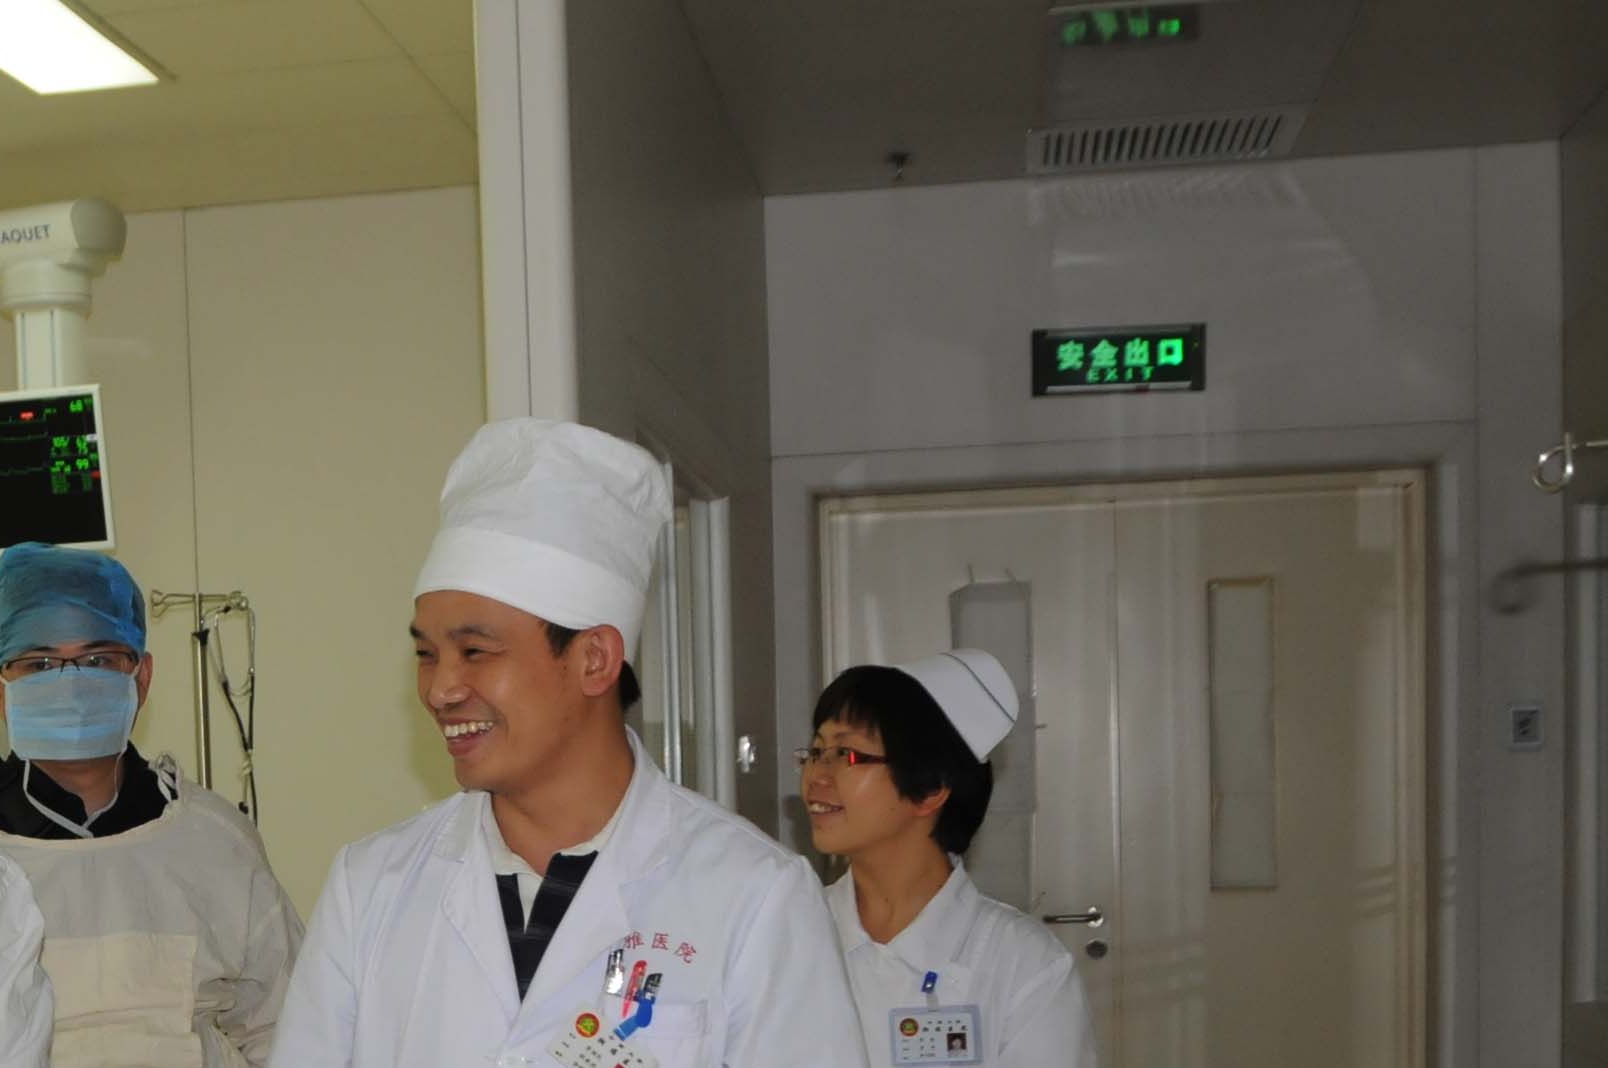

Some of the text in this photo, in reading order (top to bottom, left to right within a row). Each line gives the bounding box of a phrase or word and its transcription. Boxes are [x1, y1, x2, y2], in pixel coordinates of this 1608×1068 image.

[1056, 338, 1183, 371] 安全出口
[1086, 367, 1155, 382] EXIT
